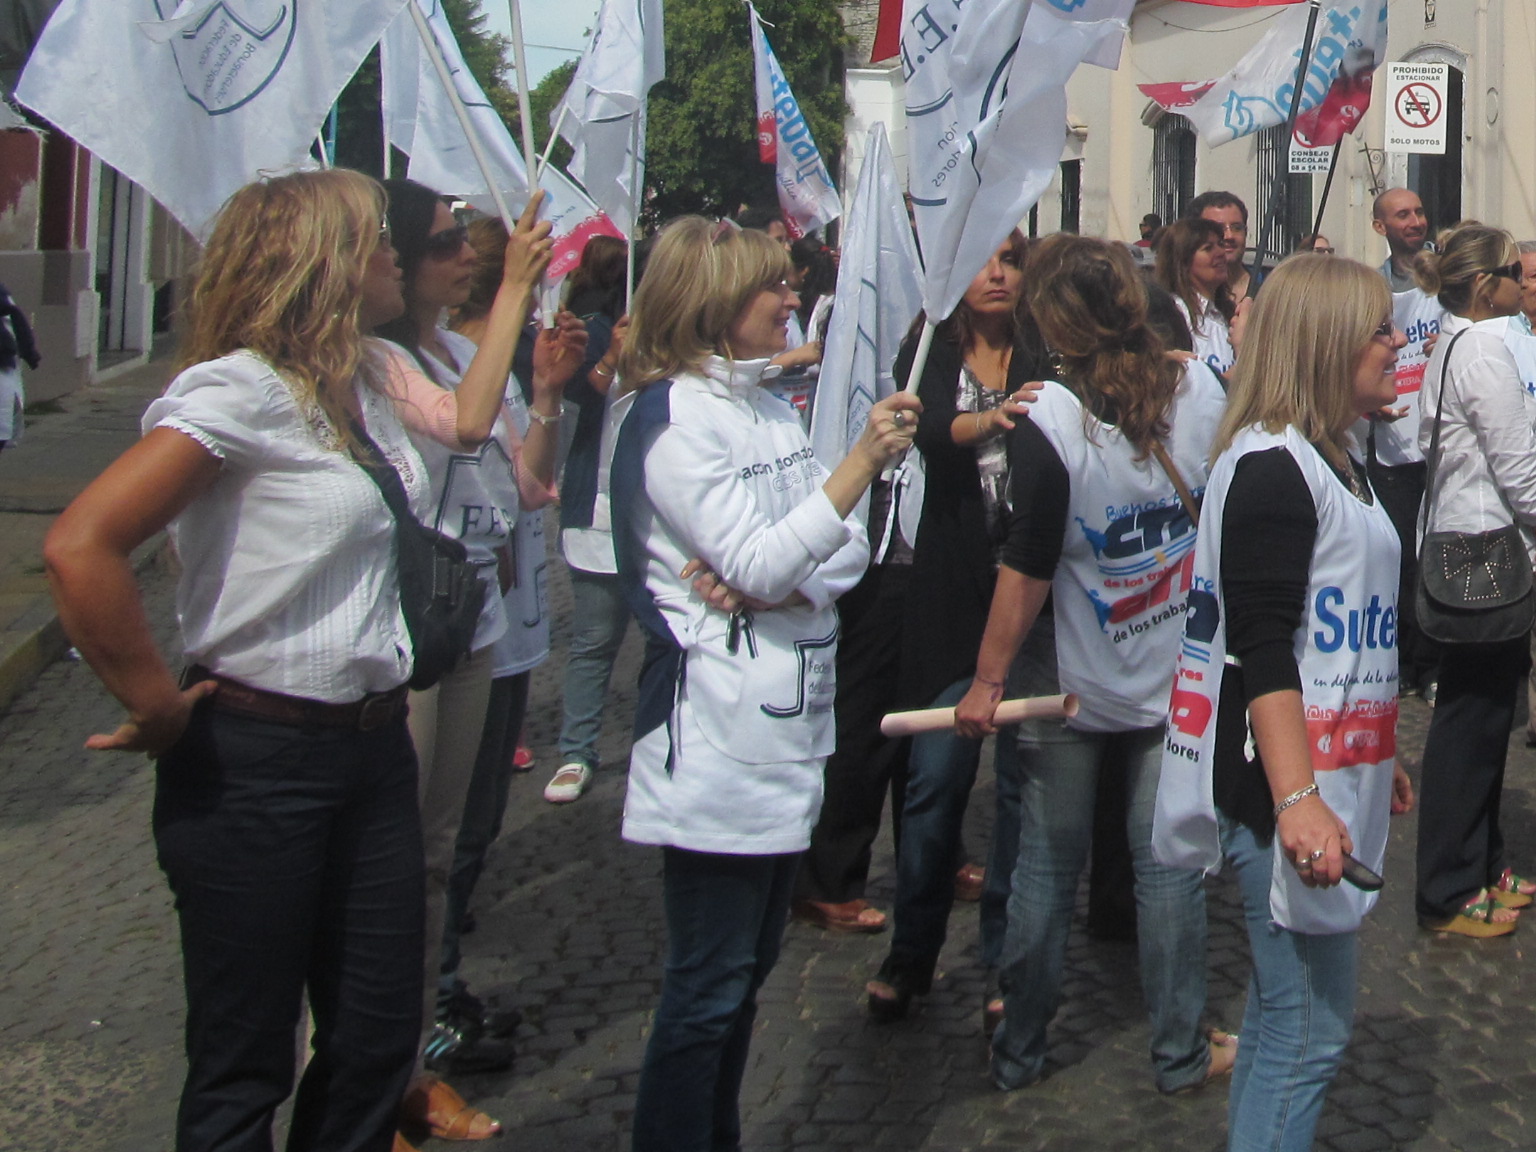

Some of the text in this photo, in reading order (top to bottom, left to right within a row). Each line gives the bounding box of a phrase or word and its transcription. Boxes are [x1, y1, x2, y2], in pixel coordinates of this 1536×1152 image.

[1392, 66, 1444, 74] PROHIBIDO
[1390, 137, 1440, 146] SOLO MOTOS
[1103, 579, 1121, 588] de
[1124, 574, 1144, 588] los
[1314, 586, 1399, 653] Sute
[1113, 630, 1128, 644] de
[1129, 619, 1150, 636] los
[1314, 677, 1327, 687] en
[1363, 671, 1373, 684] de
[1376, 669, 1384, 683] la
